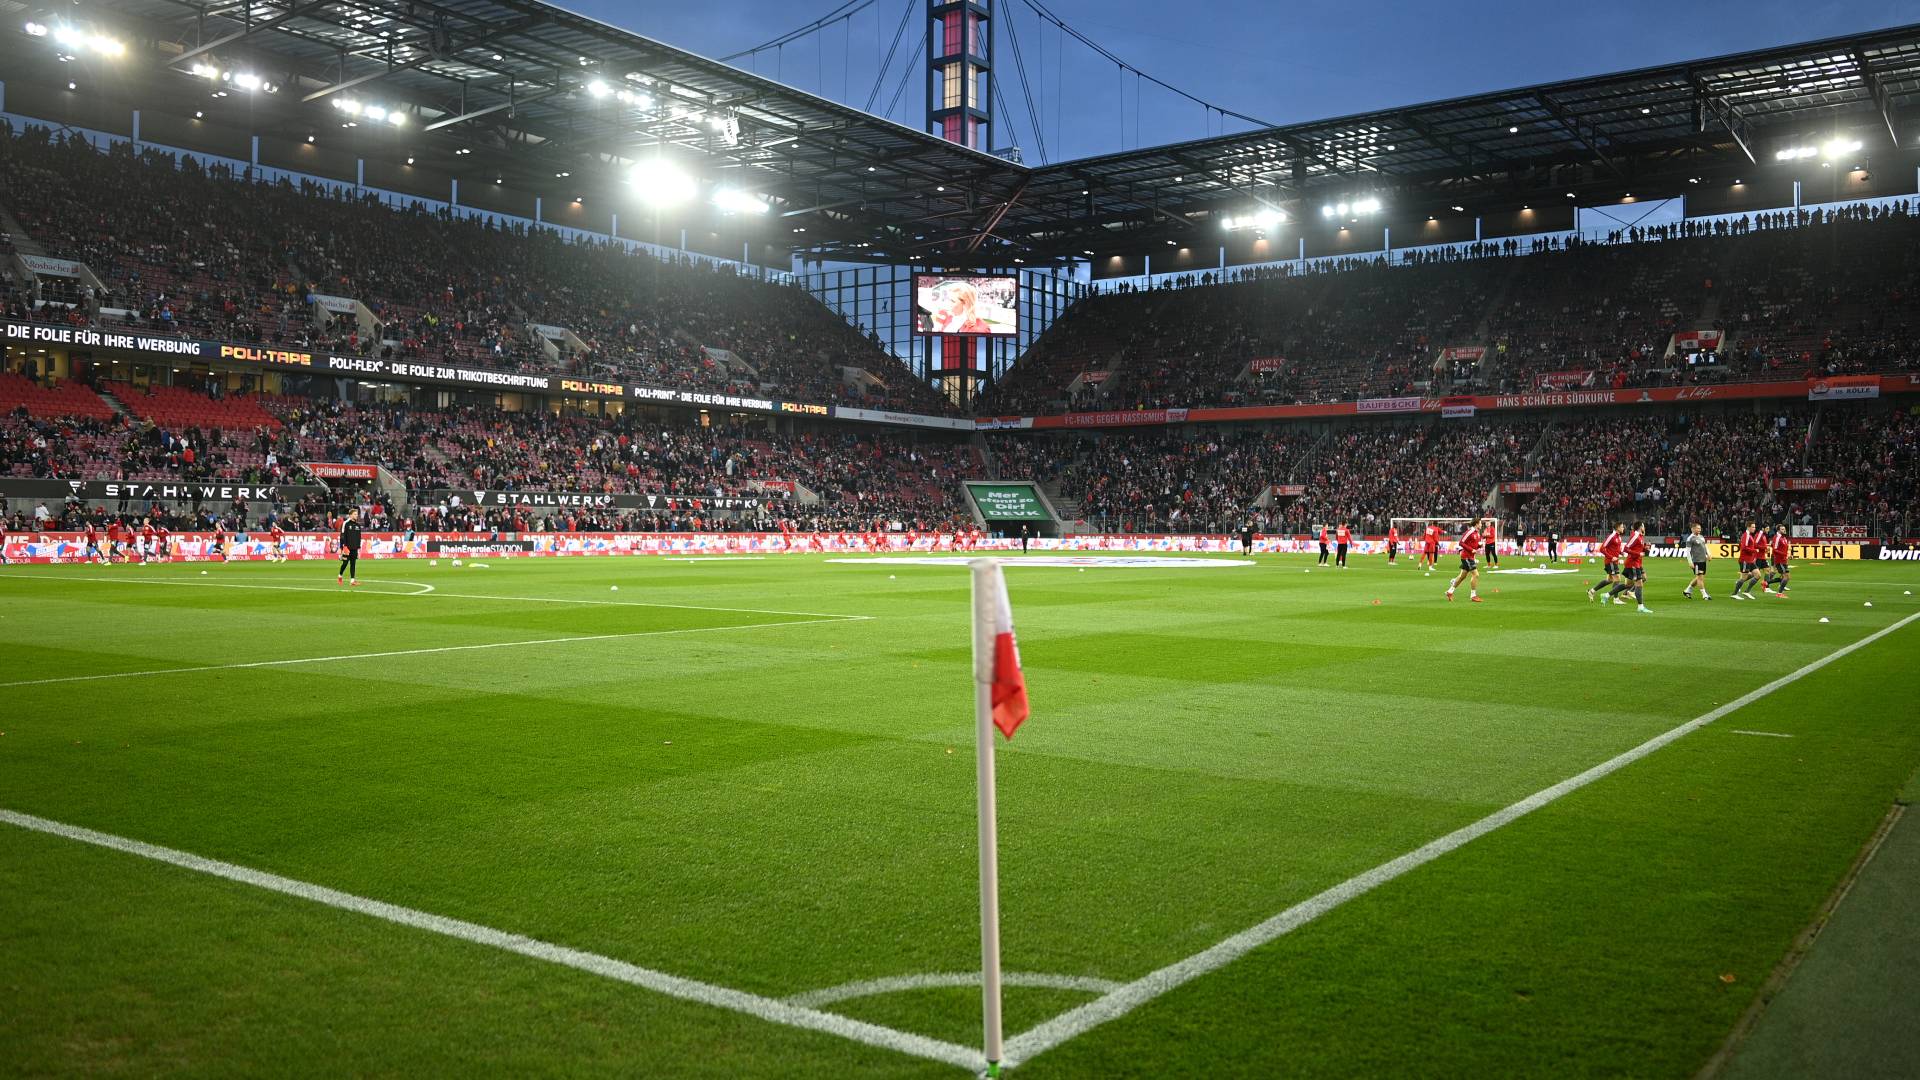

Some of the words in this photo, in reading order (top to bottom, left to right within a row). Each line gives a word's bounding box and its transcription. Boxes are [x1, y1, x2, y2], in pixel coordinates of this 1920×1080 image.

[7, 324, 31, 339] DIE
[34, 327, 71, 343] FOLIE
[74, 329, 101, 345] FÜR
[104, 335, 134, 349] IHRE
[137, 337, 200, 356] WERBUNG
[392, 363, 408, 376] DIE
[410, 365, 434, 378] FOLIE
[436, 367, 455, 380] ZUR
[457, 369, 549, 389] TRIKOTBESCHRIFTUNG
[681, 392, 693, 403] DIE
[693, 393, 711, 404] FOLIE
[711, 393, 725, 406] FÜR
[725, 396, 741, 408] IHRE
[741, 398, 773, 411] WERBUNG
[1496, 397, 1521, 408] HANS
[1522, 393, 1563, 407] SCHÄFER
[1566, 391, 1616, 404] SÜDKURVE
[1064, 414, 1095, 426] FC-FANS
[1096, 413, 1120, 425] GEGEN
[1122, 411, 1165, 424] RASSISMUS
[316, 466, 345, 477] SPÜRBAR
[988, 491, 1019, 499] Mer
[1648, 543, 1689, 557] bwin
